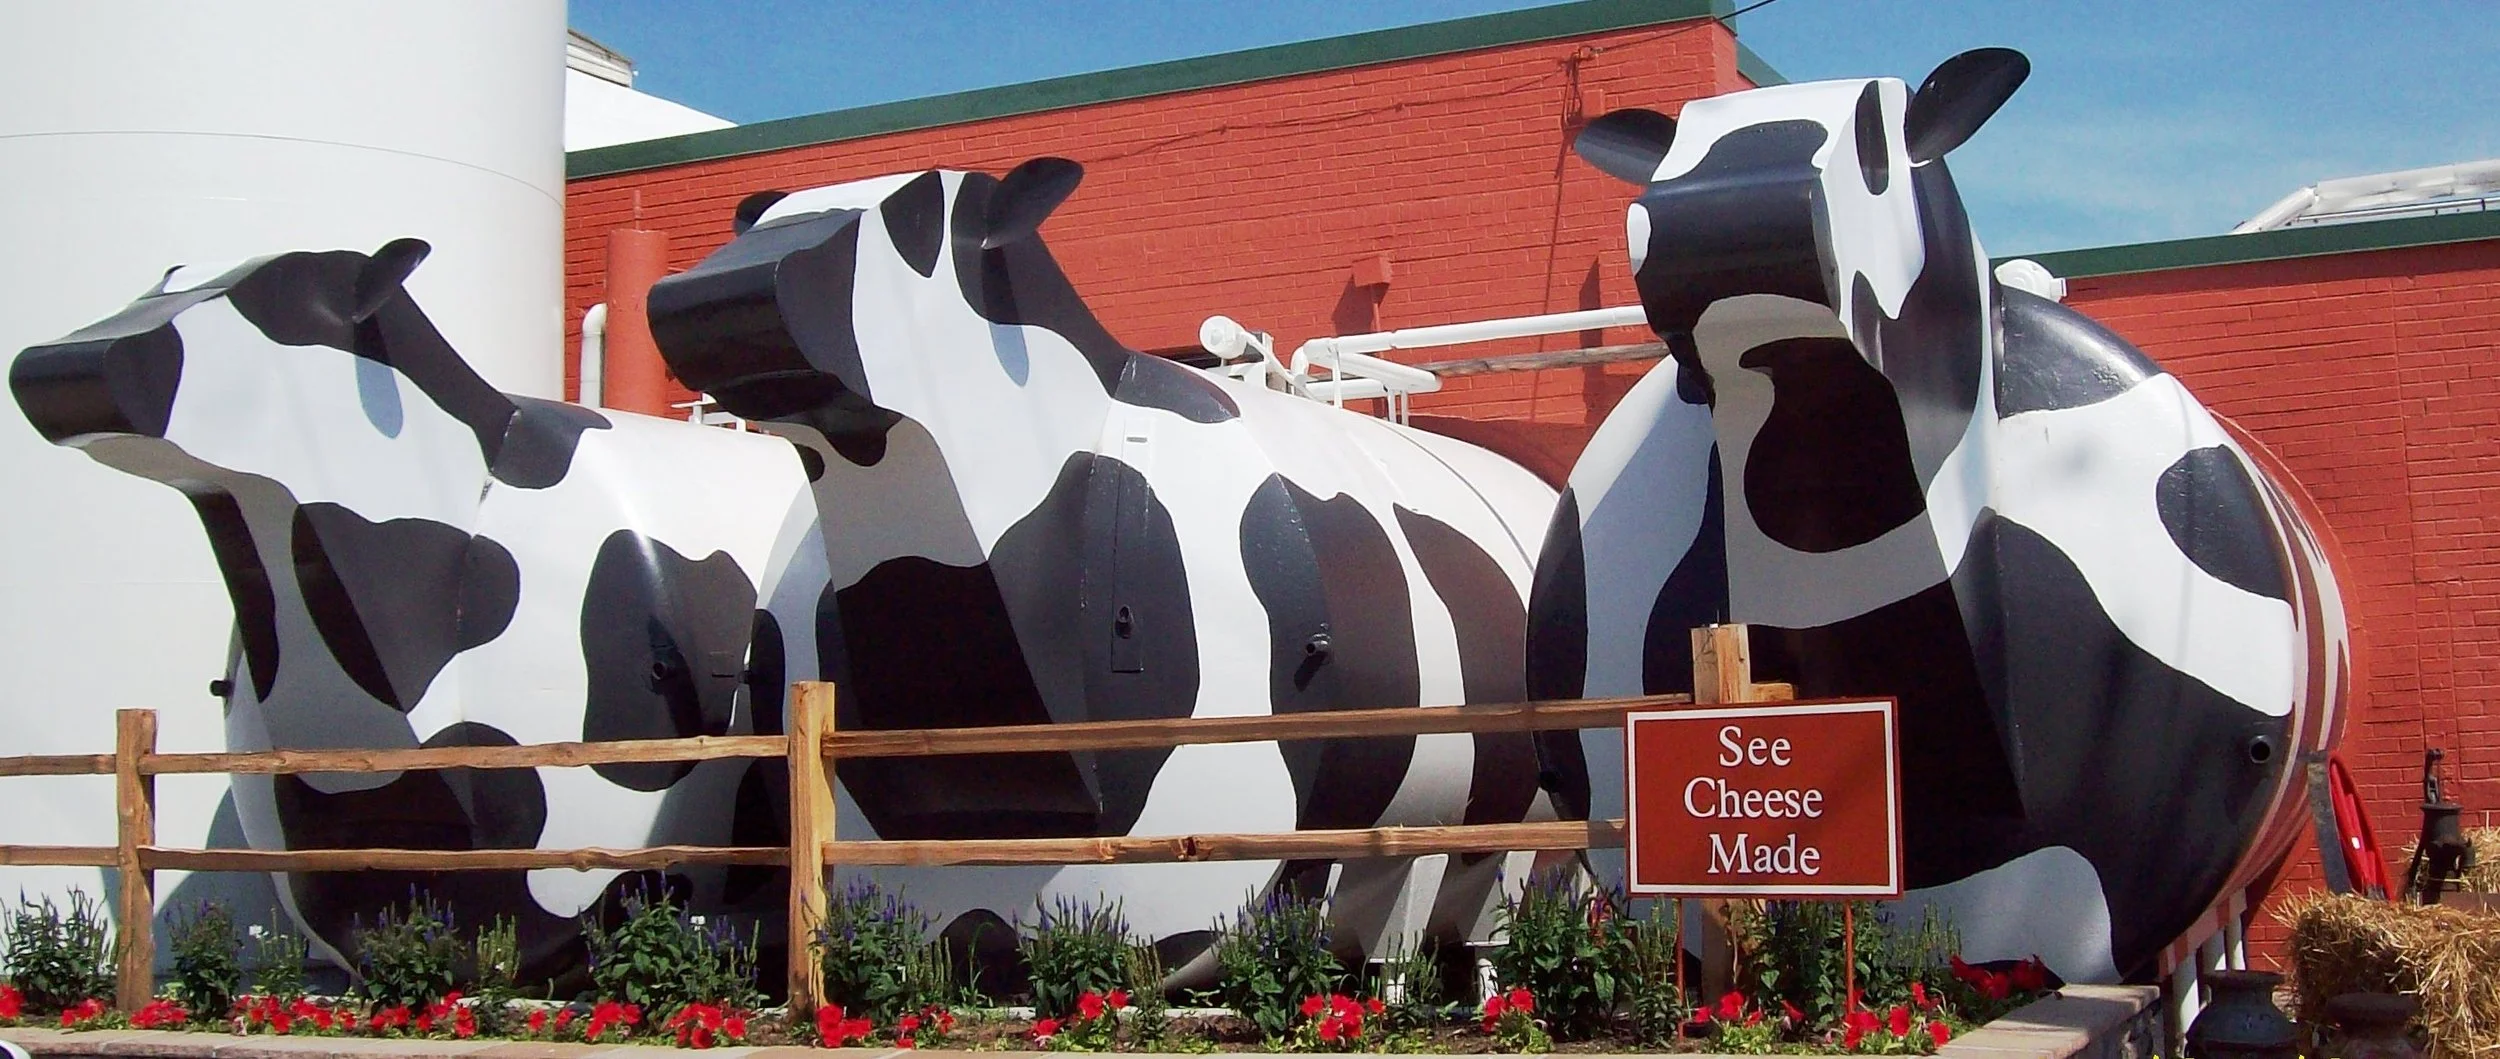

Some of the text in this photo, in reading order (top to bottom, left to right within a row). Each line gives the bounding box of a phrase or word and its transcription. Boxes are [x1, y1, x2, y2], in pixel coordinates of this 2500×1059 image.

[1719, 725, 1791, 767] See
[1684, 777, 1823, 818] Cheese
[1707, 833, 1820, 875] Made
